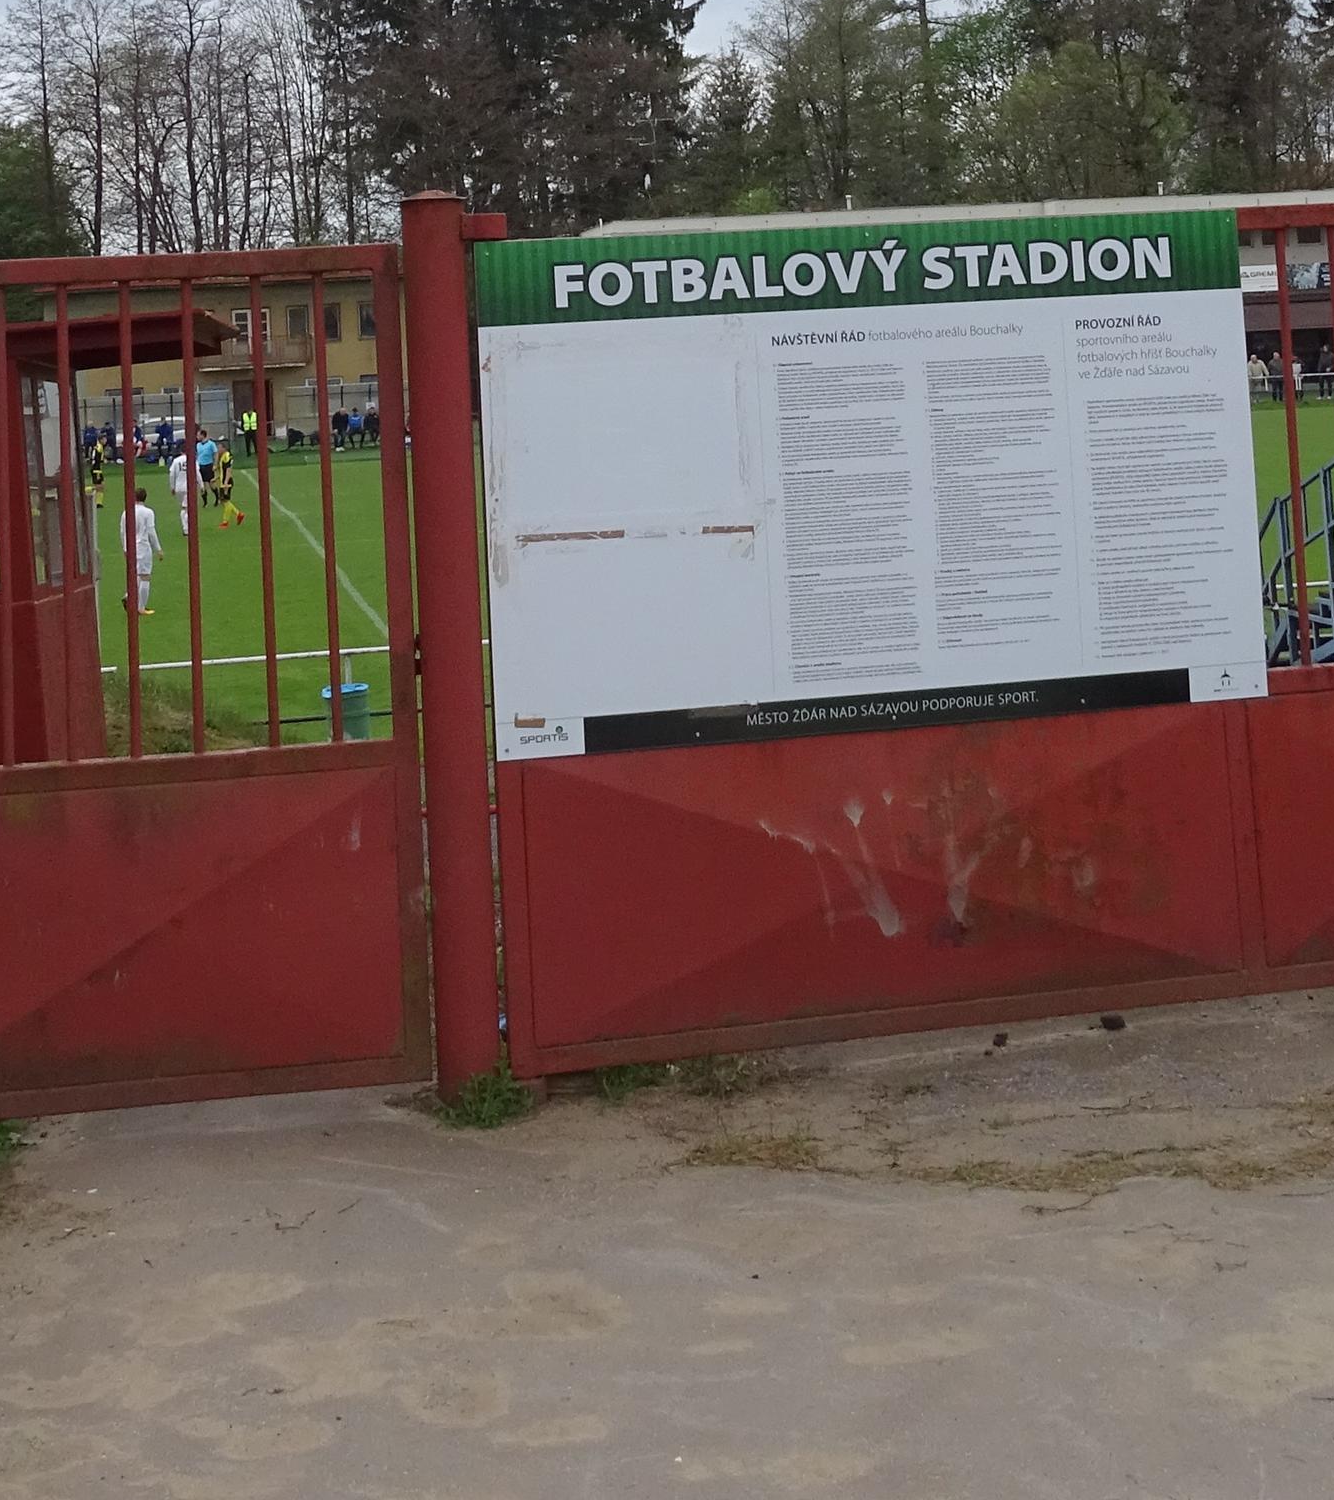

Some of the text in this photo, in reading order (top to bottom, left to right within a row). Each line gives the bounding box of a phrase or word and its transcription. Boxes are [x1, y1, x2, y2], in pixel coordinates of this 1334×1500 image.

[552, 235, 1173, 309] FOTBALOVÝ STADION
[1075, 314, 1162, 330] PROVOZNÍ ŘÁD
[771, 323, 1024, 347] NÁVŠTĚVNÍ ŘÁD fotbalového areálu Bouchalky
[1076, 331, 1173, 348] sportovního areálu
[1077, 345, 1218, 365] fotbalových hřišť Bouchalky
[1078, 363, 1190, 380] ve Žďáře nad Sázavou
[746, 690, 1039, 727] MĚSTO ŽĎÁR NAD SÁZAVOU PODPORUJE SPORT.
